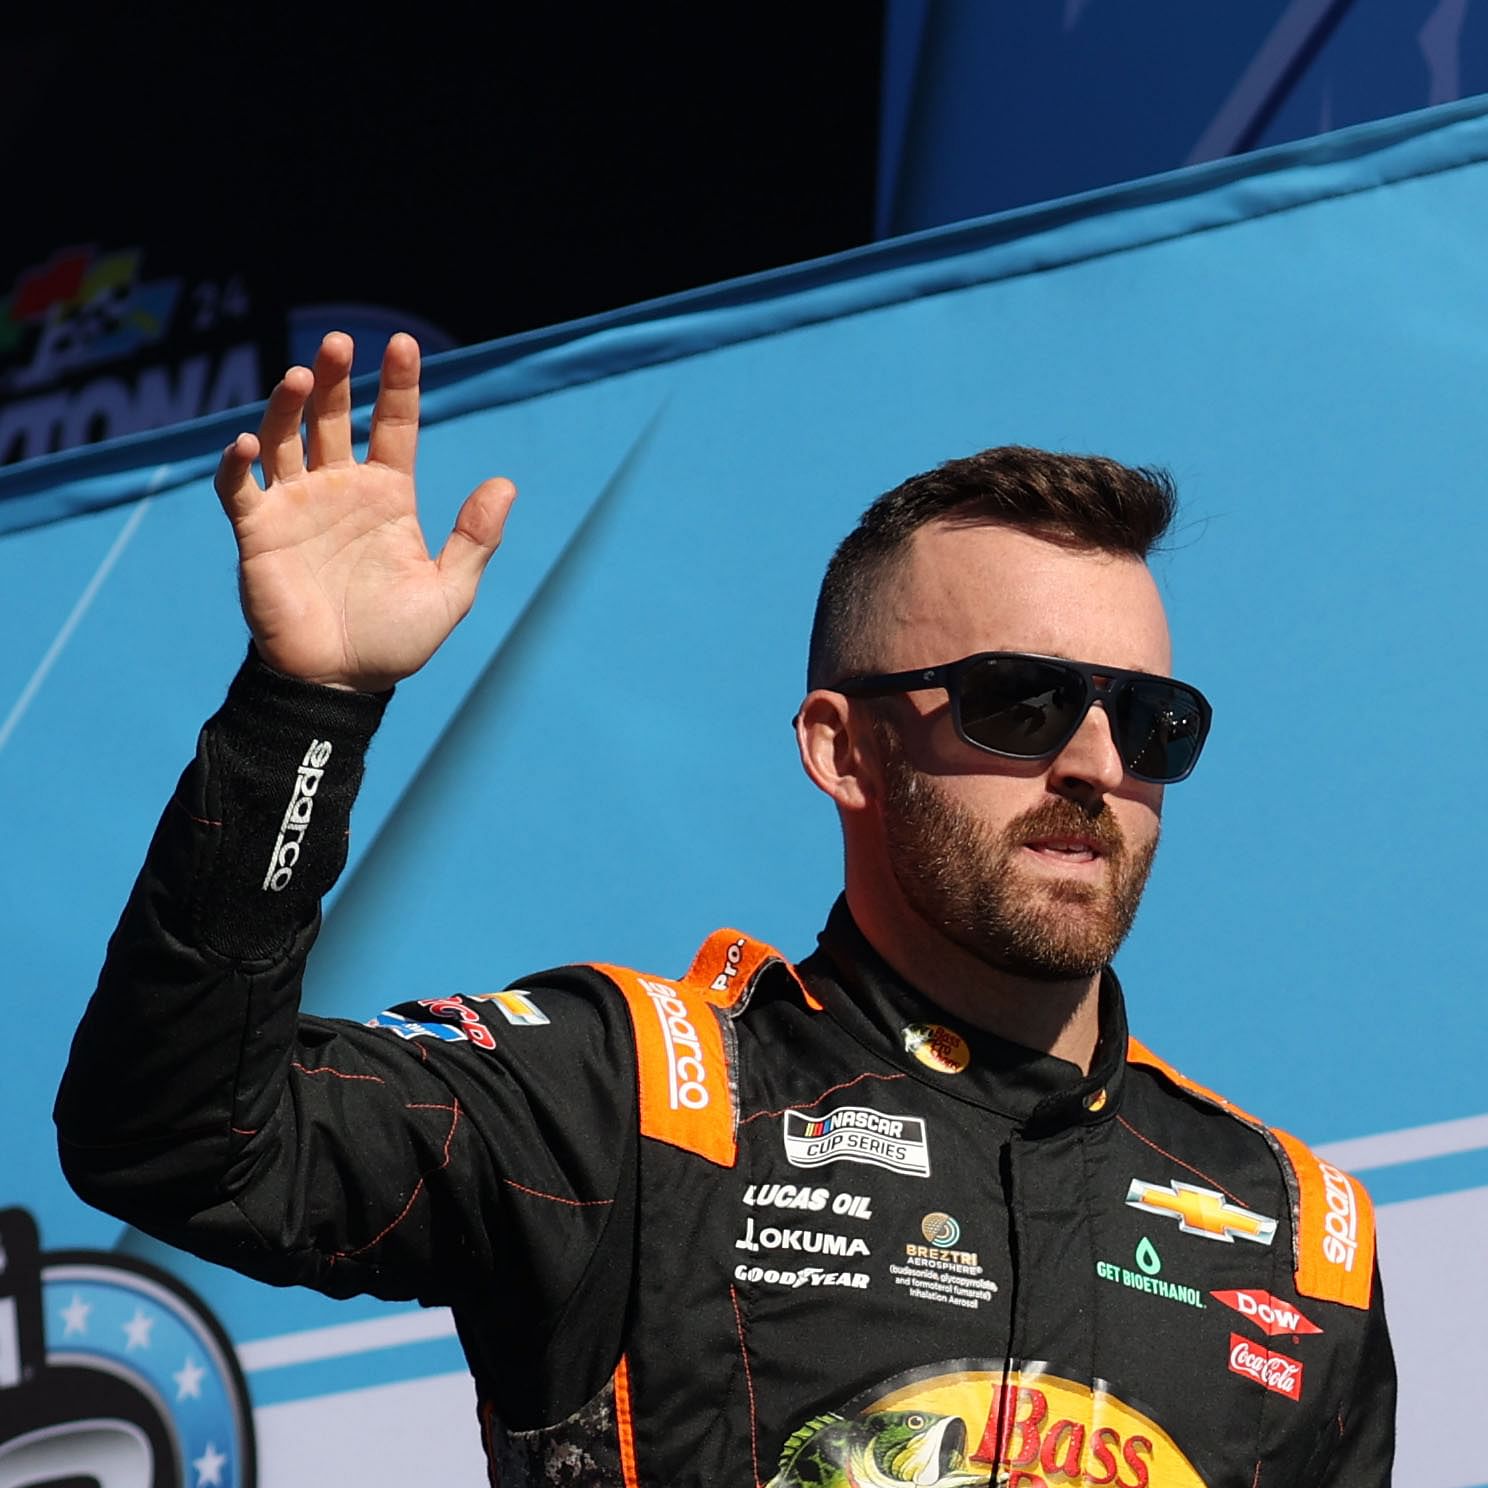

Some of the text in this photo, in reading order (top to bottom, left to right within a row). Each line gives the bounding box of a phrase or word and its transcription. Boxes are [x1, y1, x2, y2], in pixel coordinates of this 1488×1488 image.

[262, 739, 332, 891] sparco
[637, 978, 709, 1110] sparco
[829, 1111, 903, 1137] NASCAR
[807, 1135, 907, 1161] CUP SERIES
[743, 1184, 873, 1220] LUCAS OIL
[759, 1227, 870, 1256] OKUMA
[906, 1244, 978, 1266] BREZTRI
[735, 1265, 870, 1290] GOODYEAR
[1096, 1261, 1120, 1283] GET
